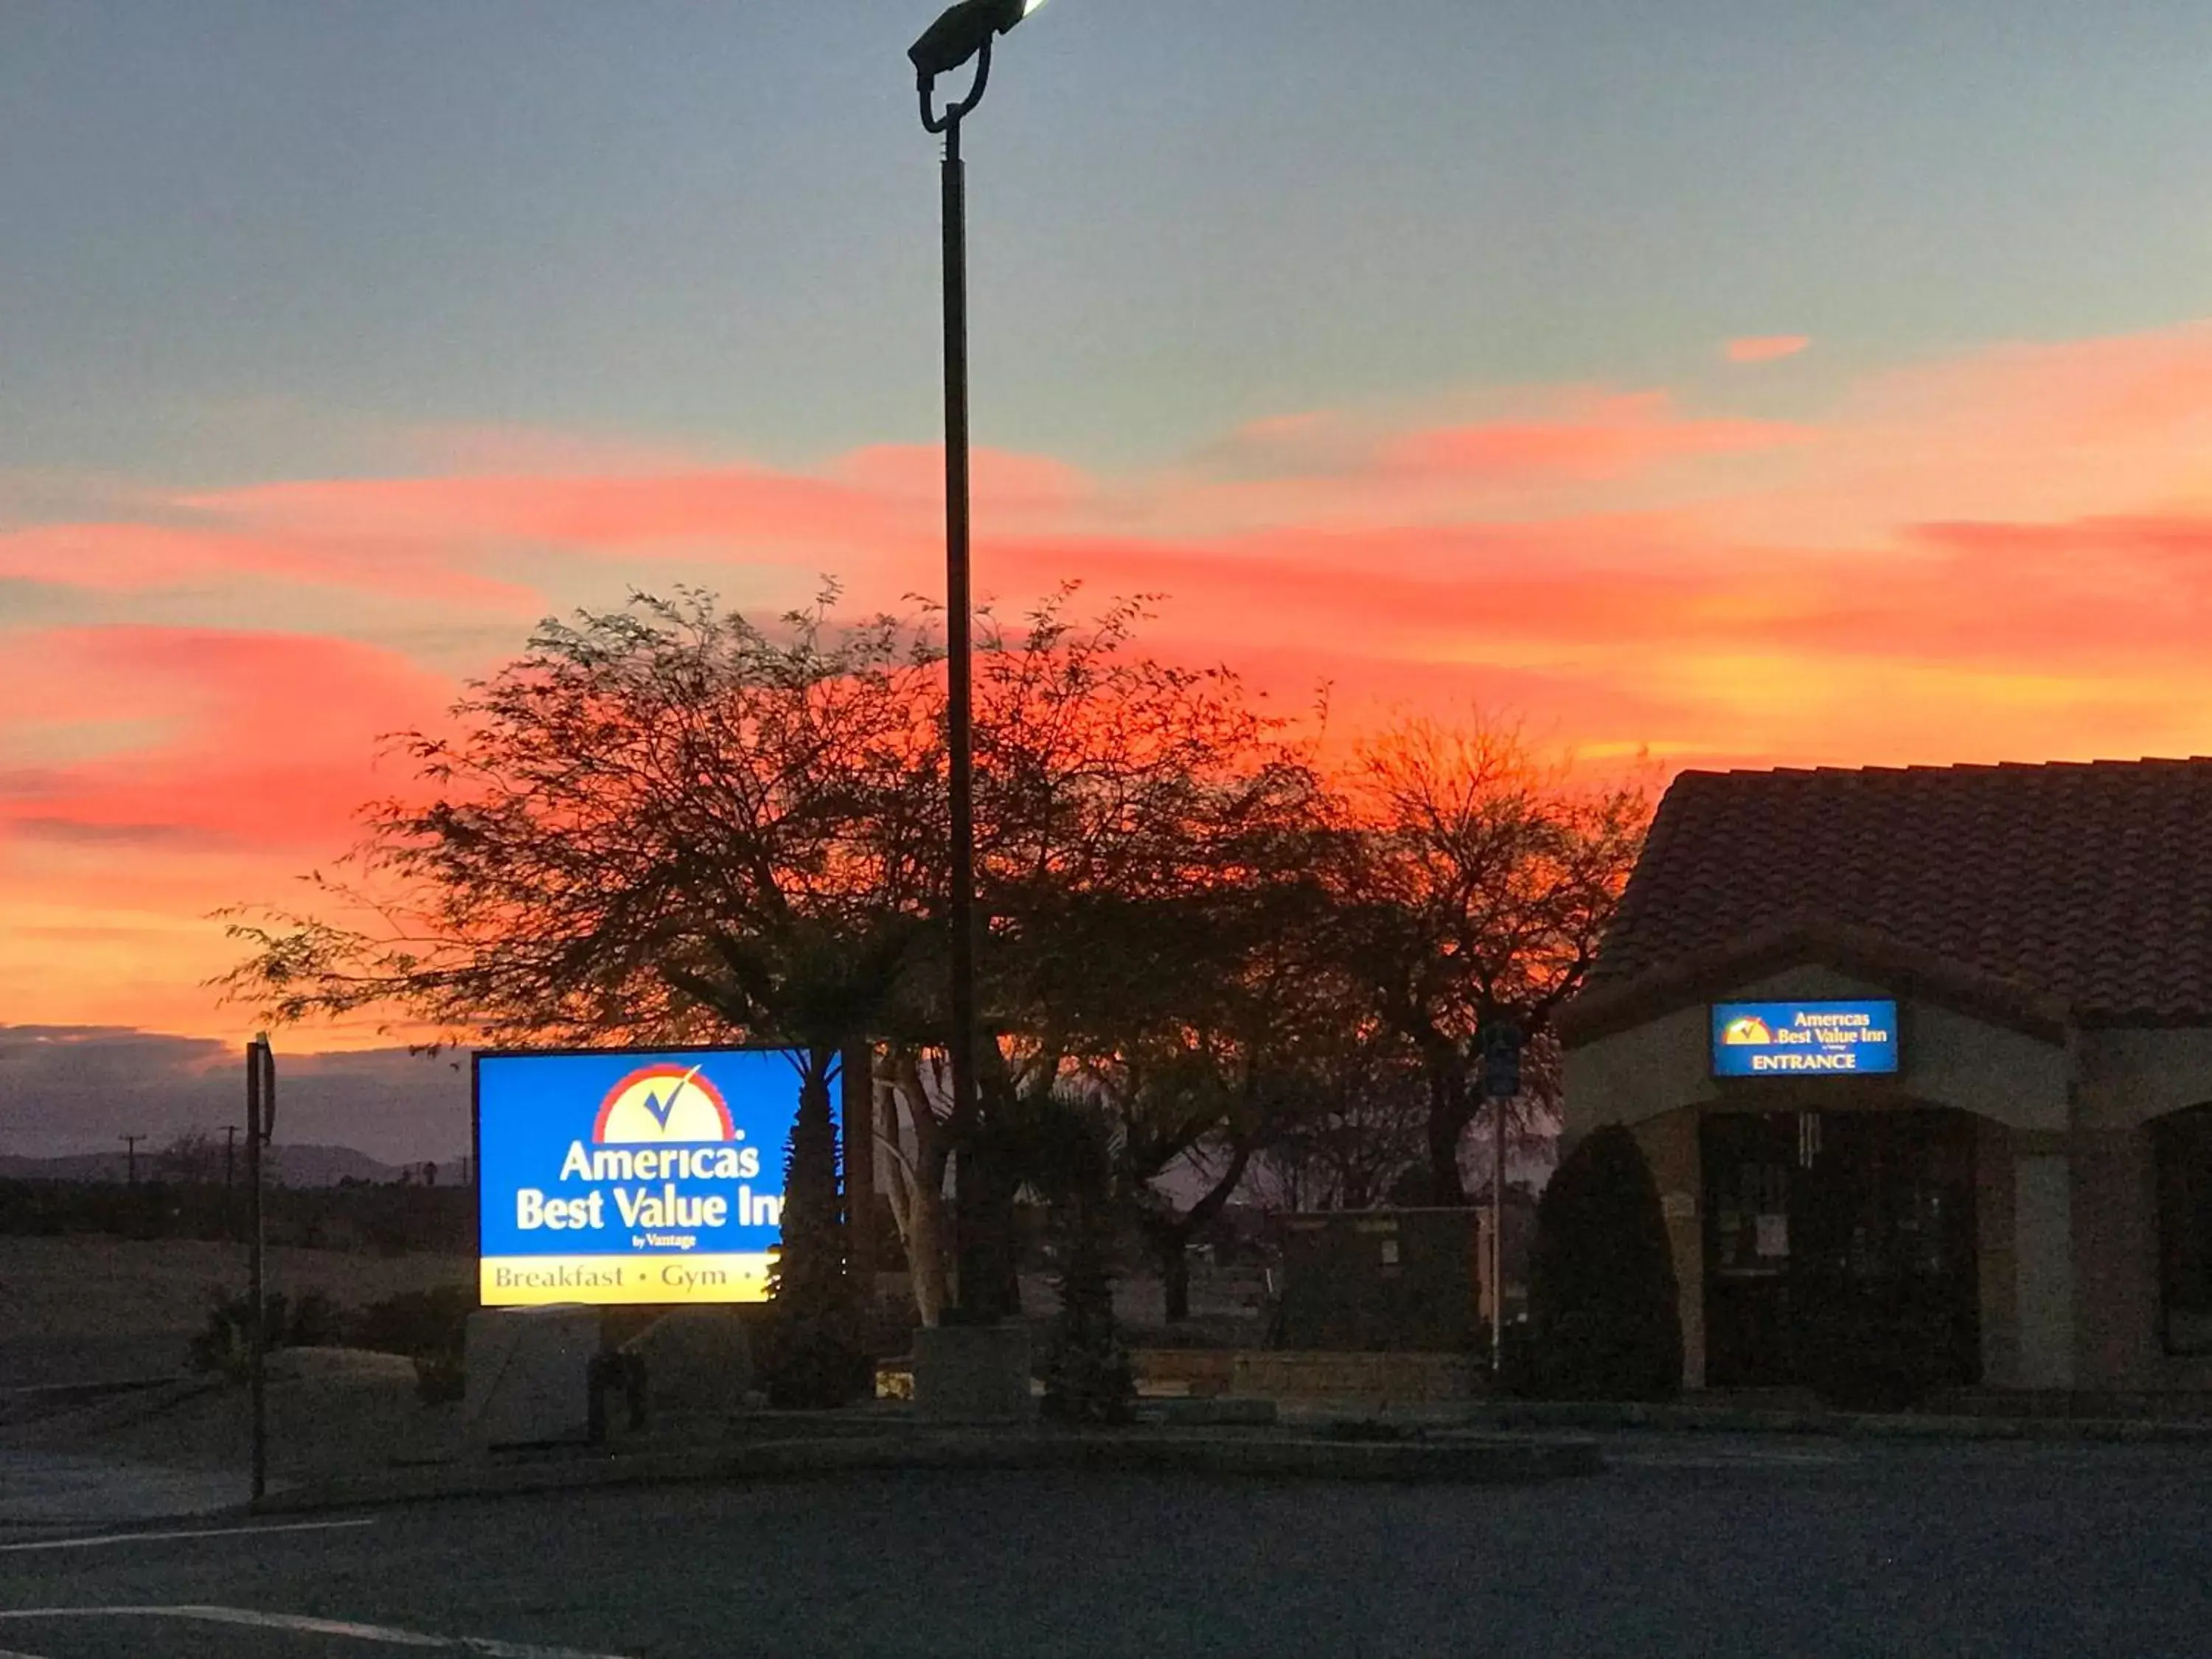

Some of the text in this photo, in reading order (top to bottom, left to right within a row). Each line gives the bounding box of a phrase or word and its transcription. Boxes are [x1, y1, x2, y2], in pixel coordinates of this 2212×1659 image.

[1795, 1012, 1870, 1027] Americas
[1778, 1028, 1888, 1044] Best Value Inn
[1752, 1054, 1856, 1070] ENTRANCE
[560, 1140, 759, 1180] Americas
[517, 1187, 604, 1230] Best
[613, 1183, 727, 1229] Value
[632, 1233, 697, 1251] by Vantage
[495, 1264, 726, 1293] Breakfast Gym
